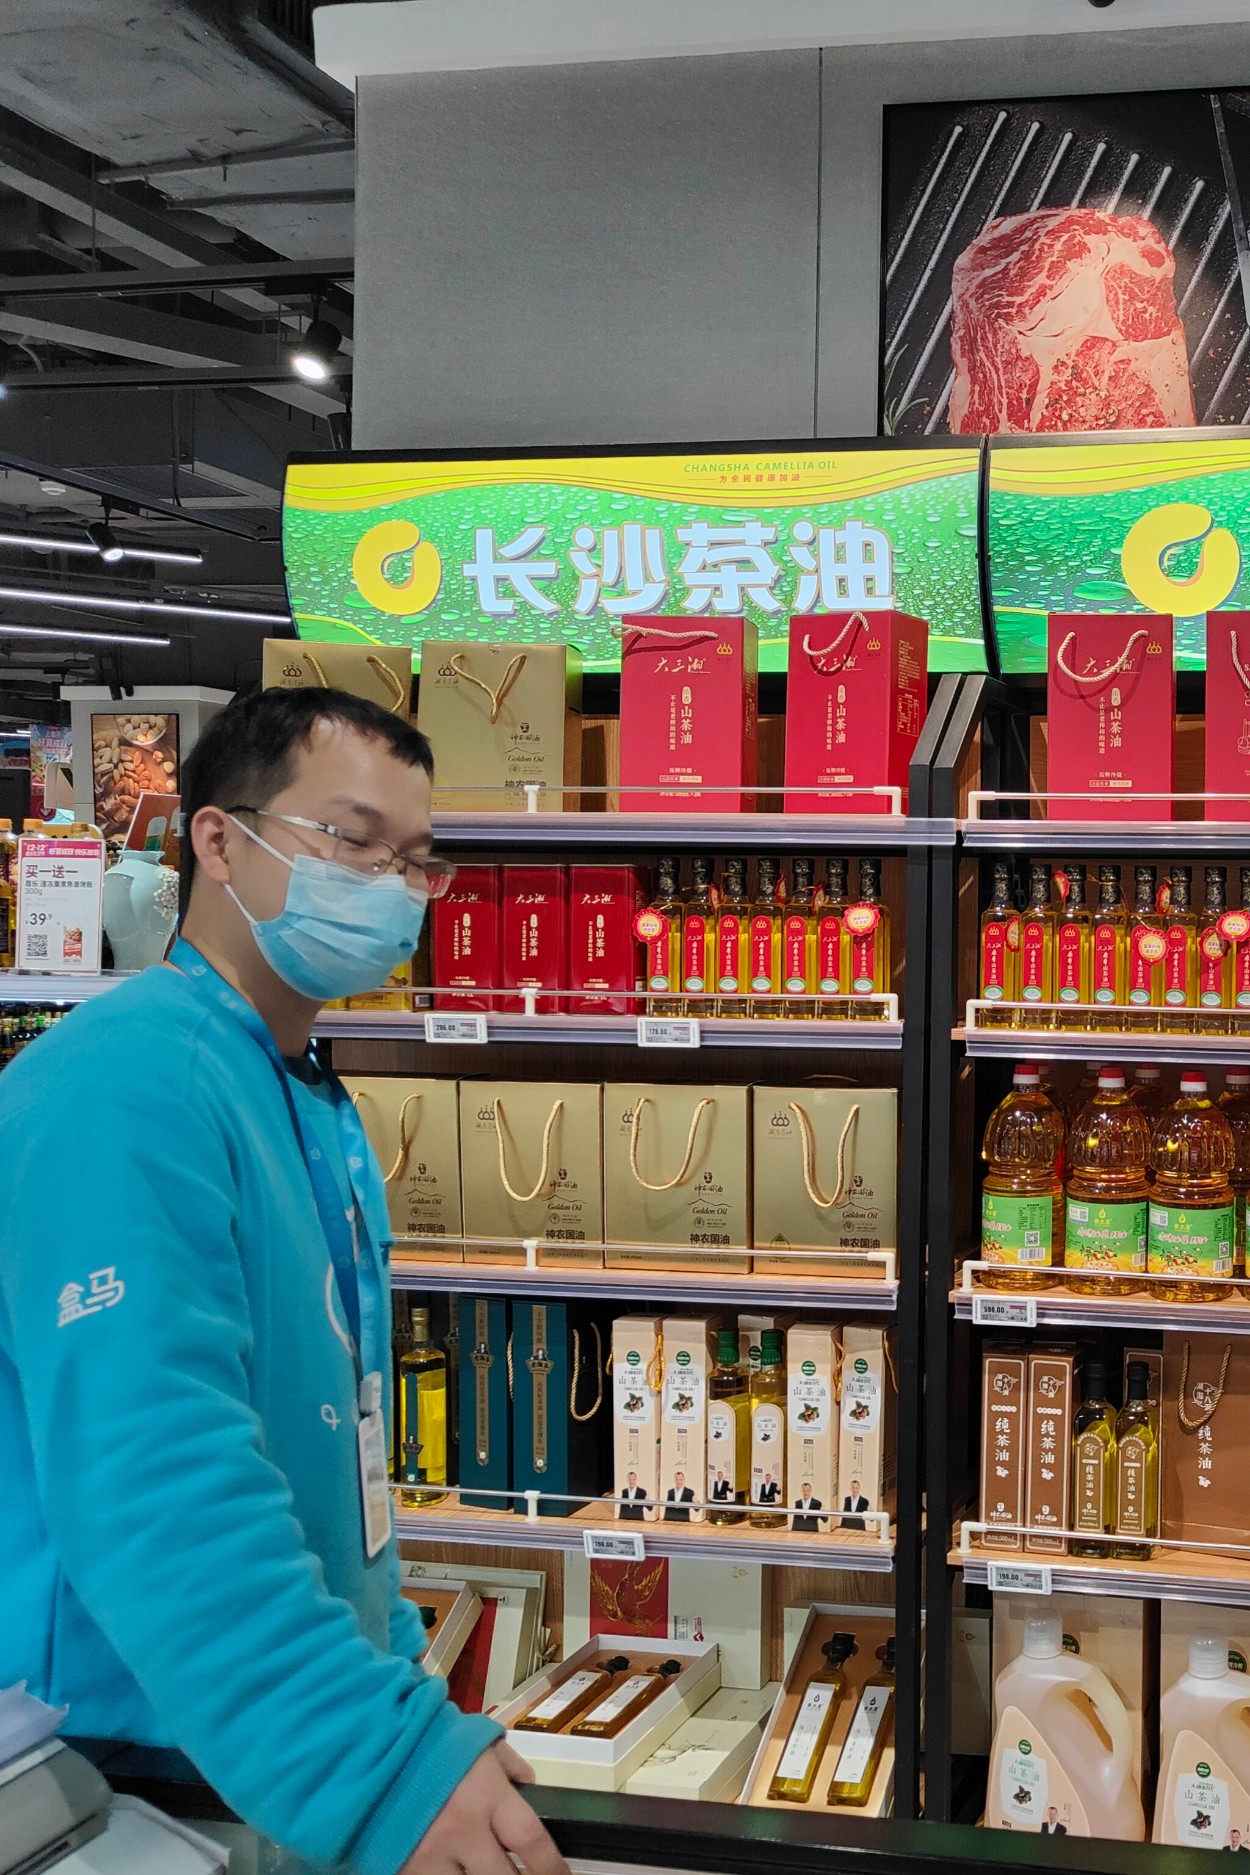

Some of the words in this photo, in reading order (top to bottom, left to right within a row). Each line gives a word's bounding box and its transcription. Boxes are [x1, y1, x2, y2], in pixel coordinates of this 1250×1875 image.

[683, 462, 751, 474] CHANGSHA
[755, 461, 814, 472] CAMELLIA
[817, 460, 838, 470] OIL
[718, 473, 802, 484] 为全民健康加油
[463, 518, 896, 615] 长沙茶油
[680, 705, 694, 745] 山茶油
[835, 704, 848, 744] 山茶油
[1109, 707, 1123, 748] 山茶油
[25, 864, 79, 879] 买一送一
[24, 888, 43, 896] 300g
[461, 927, 472, 956] 山茶油
[529, 929, 539, 957] 山茶油
[595, 930, 605, 958] 山茶油
[428, 1197, 442, 1205] Oil
[568, 1203, 582, 1212] Oil
[713, 1206, 728, 1215] Oil
[863, 1211, 878, 1219] Oil
[407, 1222, 446, 1234] 神农国油
[545, 1229, 586, 1241] 神农国油
[689, 1233, 731, 1246] 神农国油
[839, 1237, 881, 1249] 神农国油
[57, 1265, 125, 1328] 盒马
[983, 1305, 1005, 1314] 598.00
[667, 1375, 700, 1386] 山茶油
[793, 1385, 827, 1397] 山茶油
[846, 1382, 877, 1395] 山茶油
[994, 1417, 1012, 1462] 纯茶油
[1039, 1419, 1057, 1465] 纯茶油
[1197, 1425, 1213, 1470] 纯茶油
[1184, 1789, 1221, 1805] 山茶油
